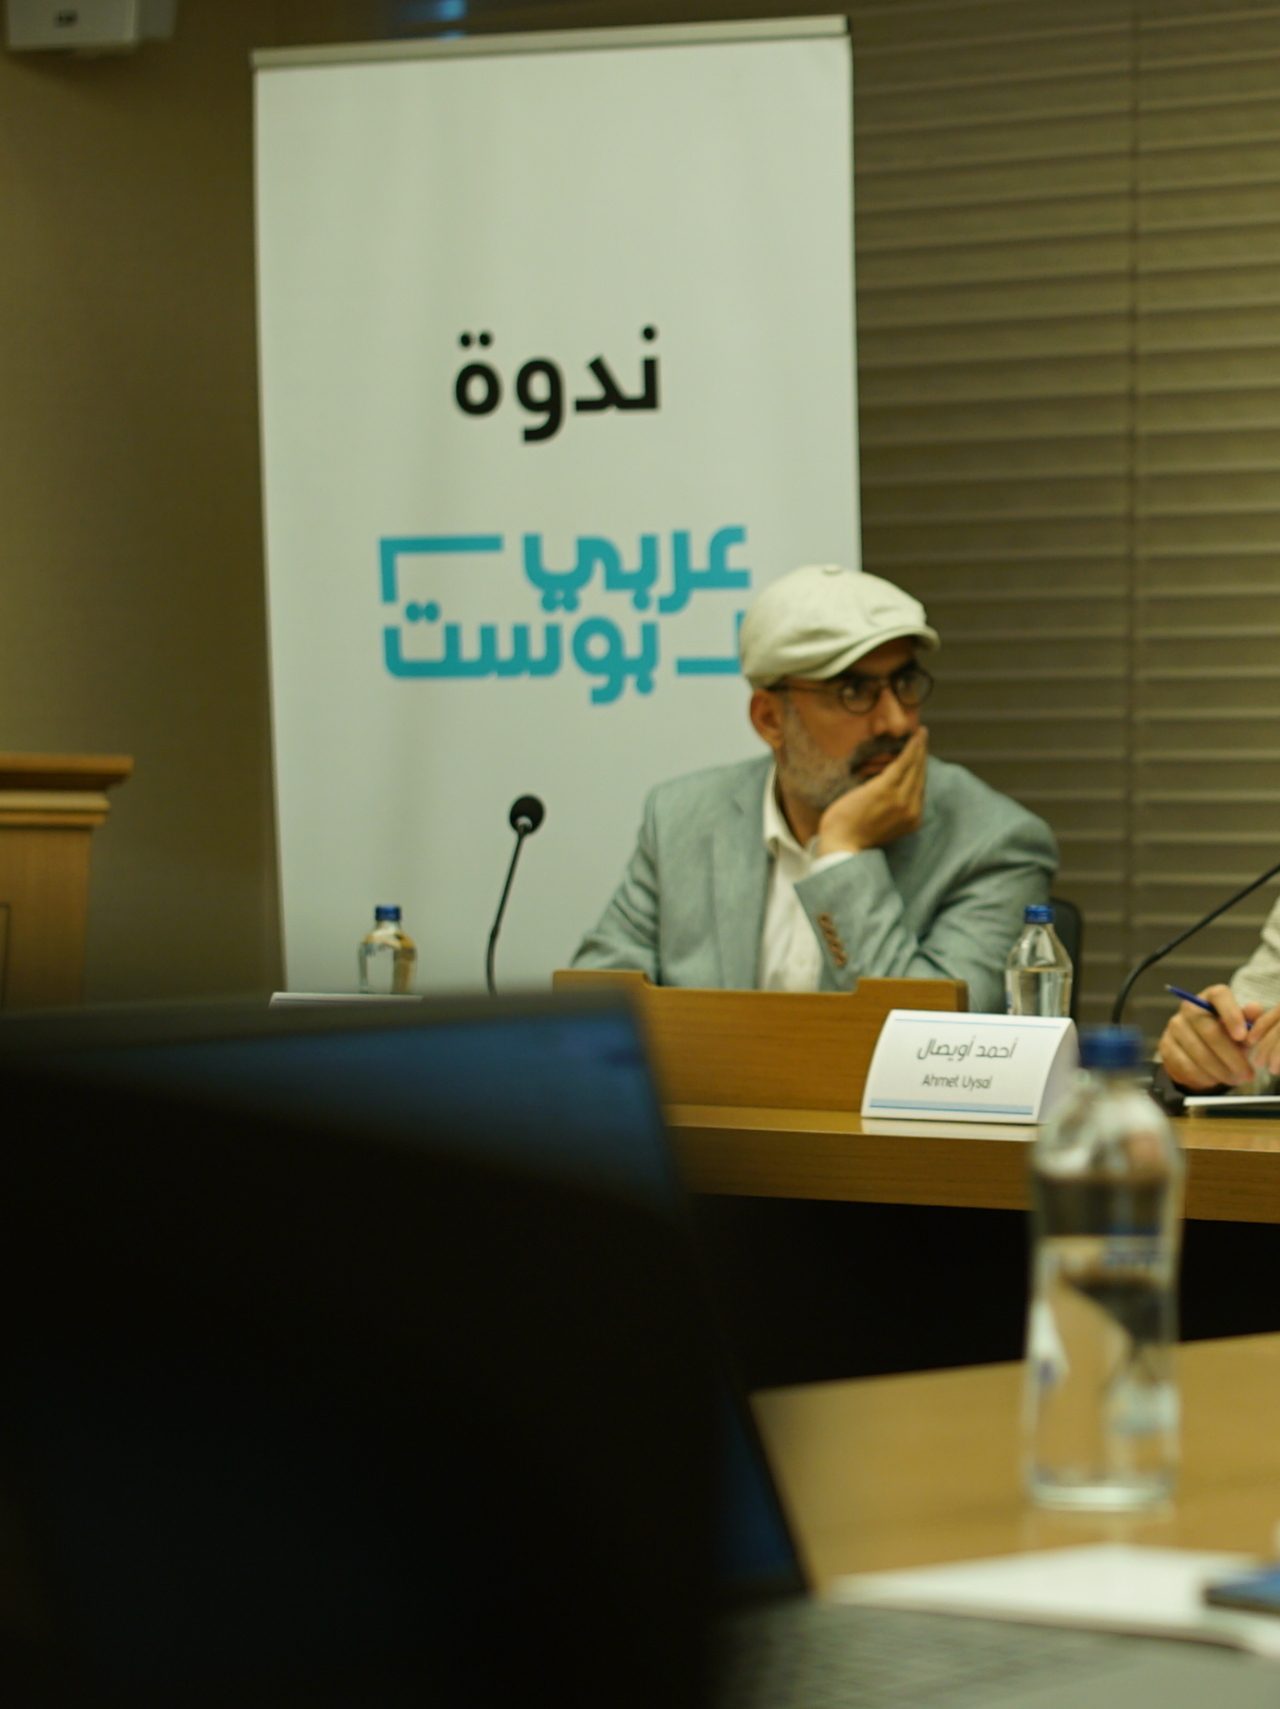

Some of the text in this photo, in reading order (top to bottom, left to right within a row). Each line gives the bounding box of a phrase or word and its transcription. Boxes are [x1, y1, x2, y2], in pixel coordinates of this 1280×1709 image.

[455, 325, 660, 443] ندوة
[521, 525, 751, 615] عربي
[383, 601, 659, 704] بوست
[921, 1073, 993, 1092] Ahmet Uysal
[975, 1037, 1019, 1059] أحمد
